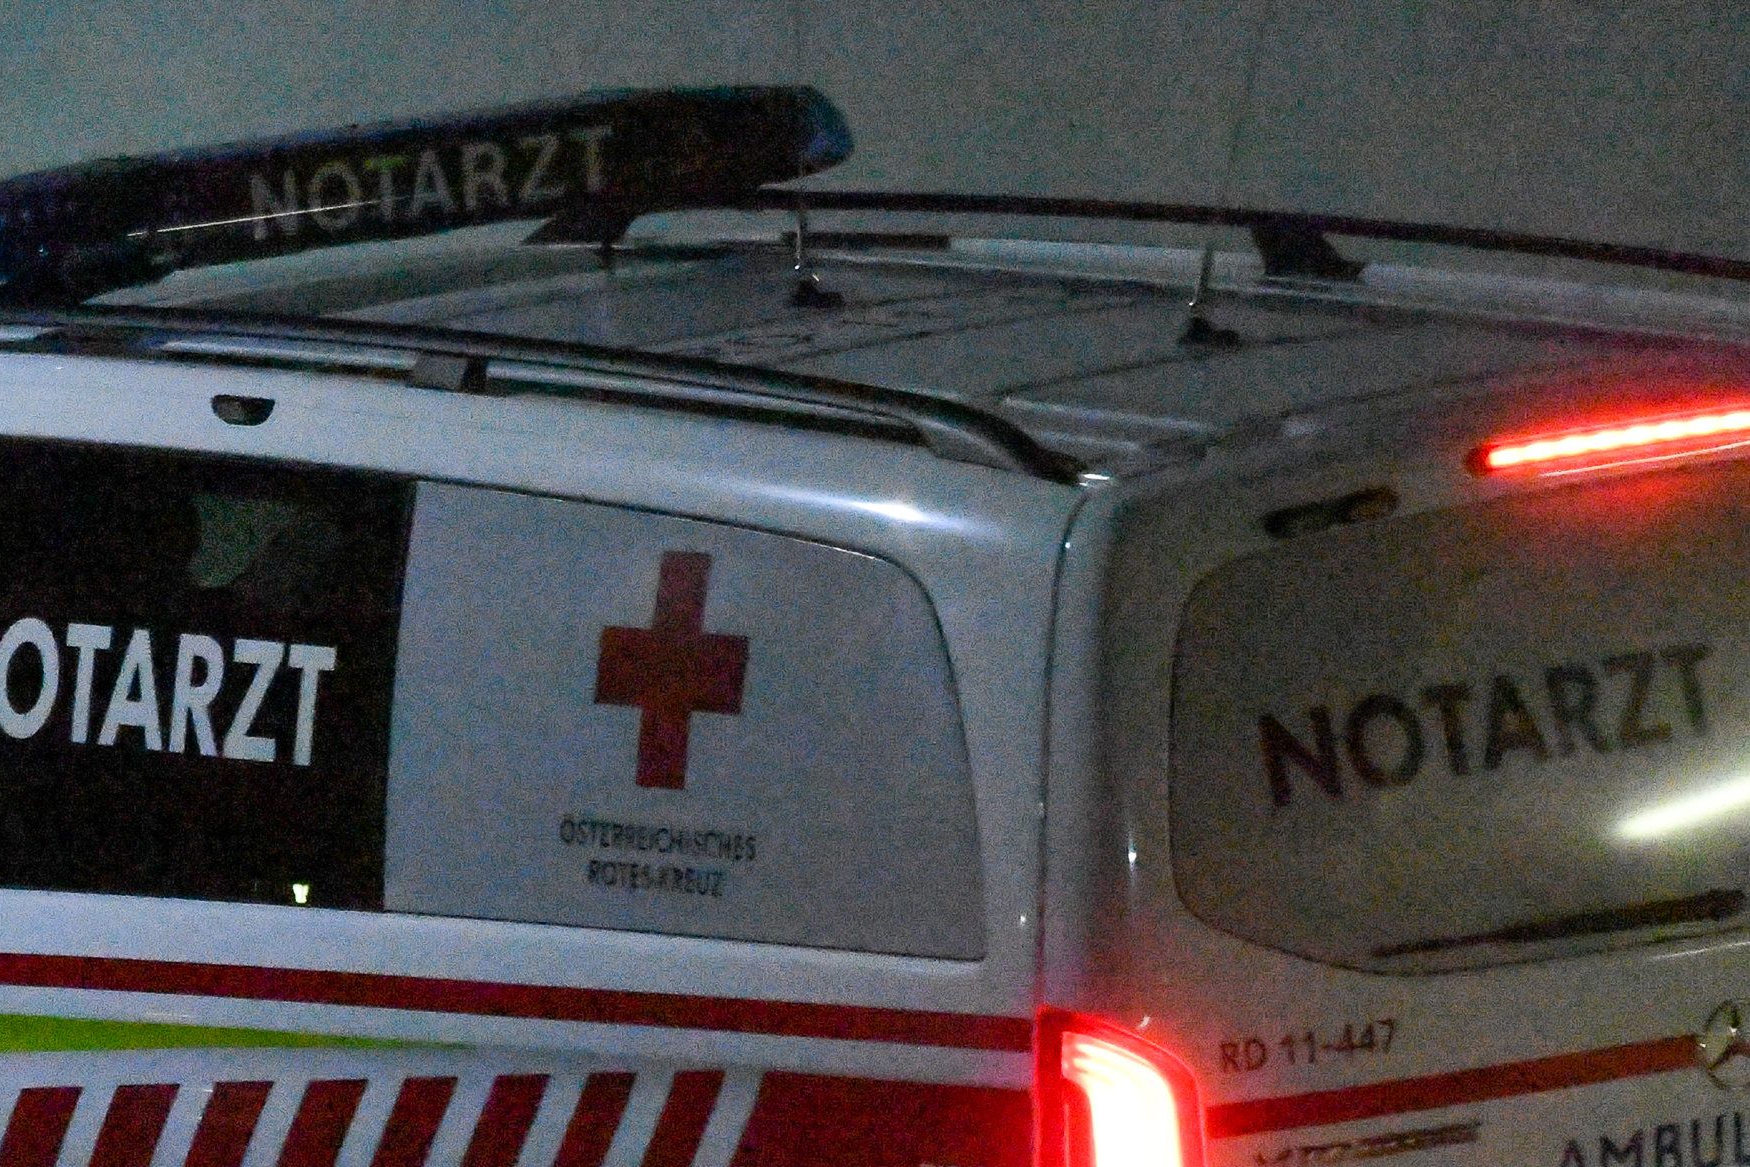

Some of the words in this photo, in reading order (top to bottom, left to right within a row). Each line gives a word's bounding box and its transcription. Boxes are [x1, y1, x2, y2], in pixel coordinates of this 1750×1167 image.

[251, 126, 612, 241] NOTARZT
[1257, 643, 1713, 806] NOTARZT
[1219, 1037, 1269, 1074] RD
[1279, 1017, 1395, 1065] 11-447
